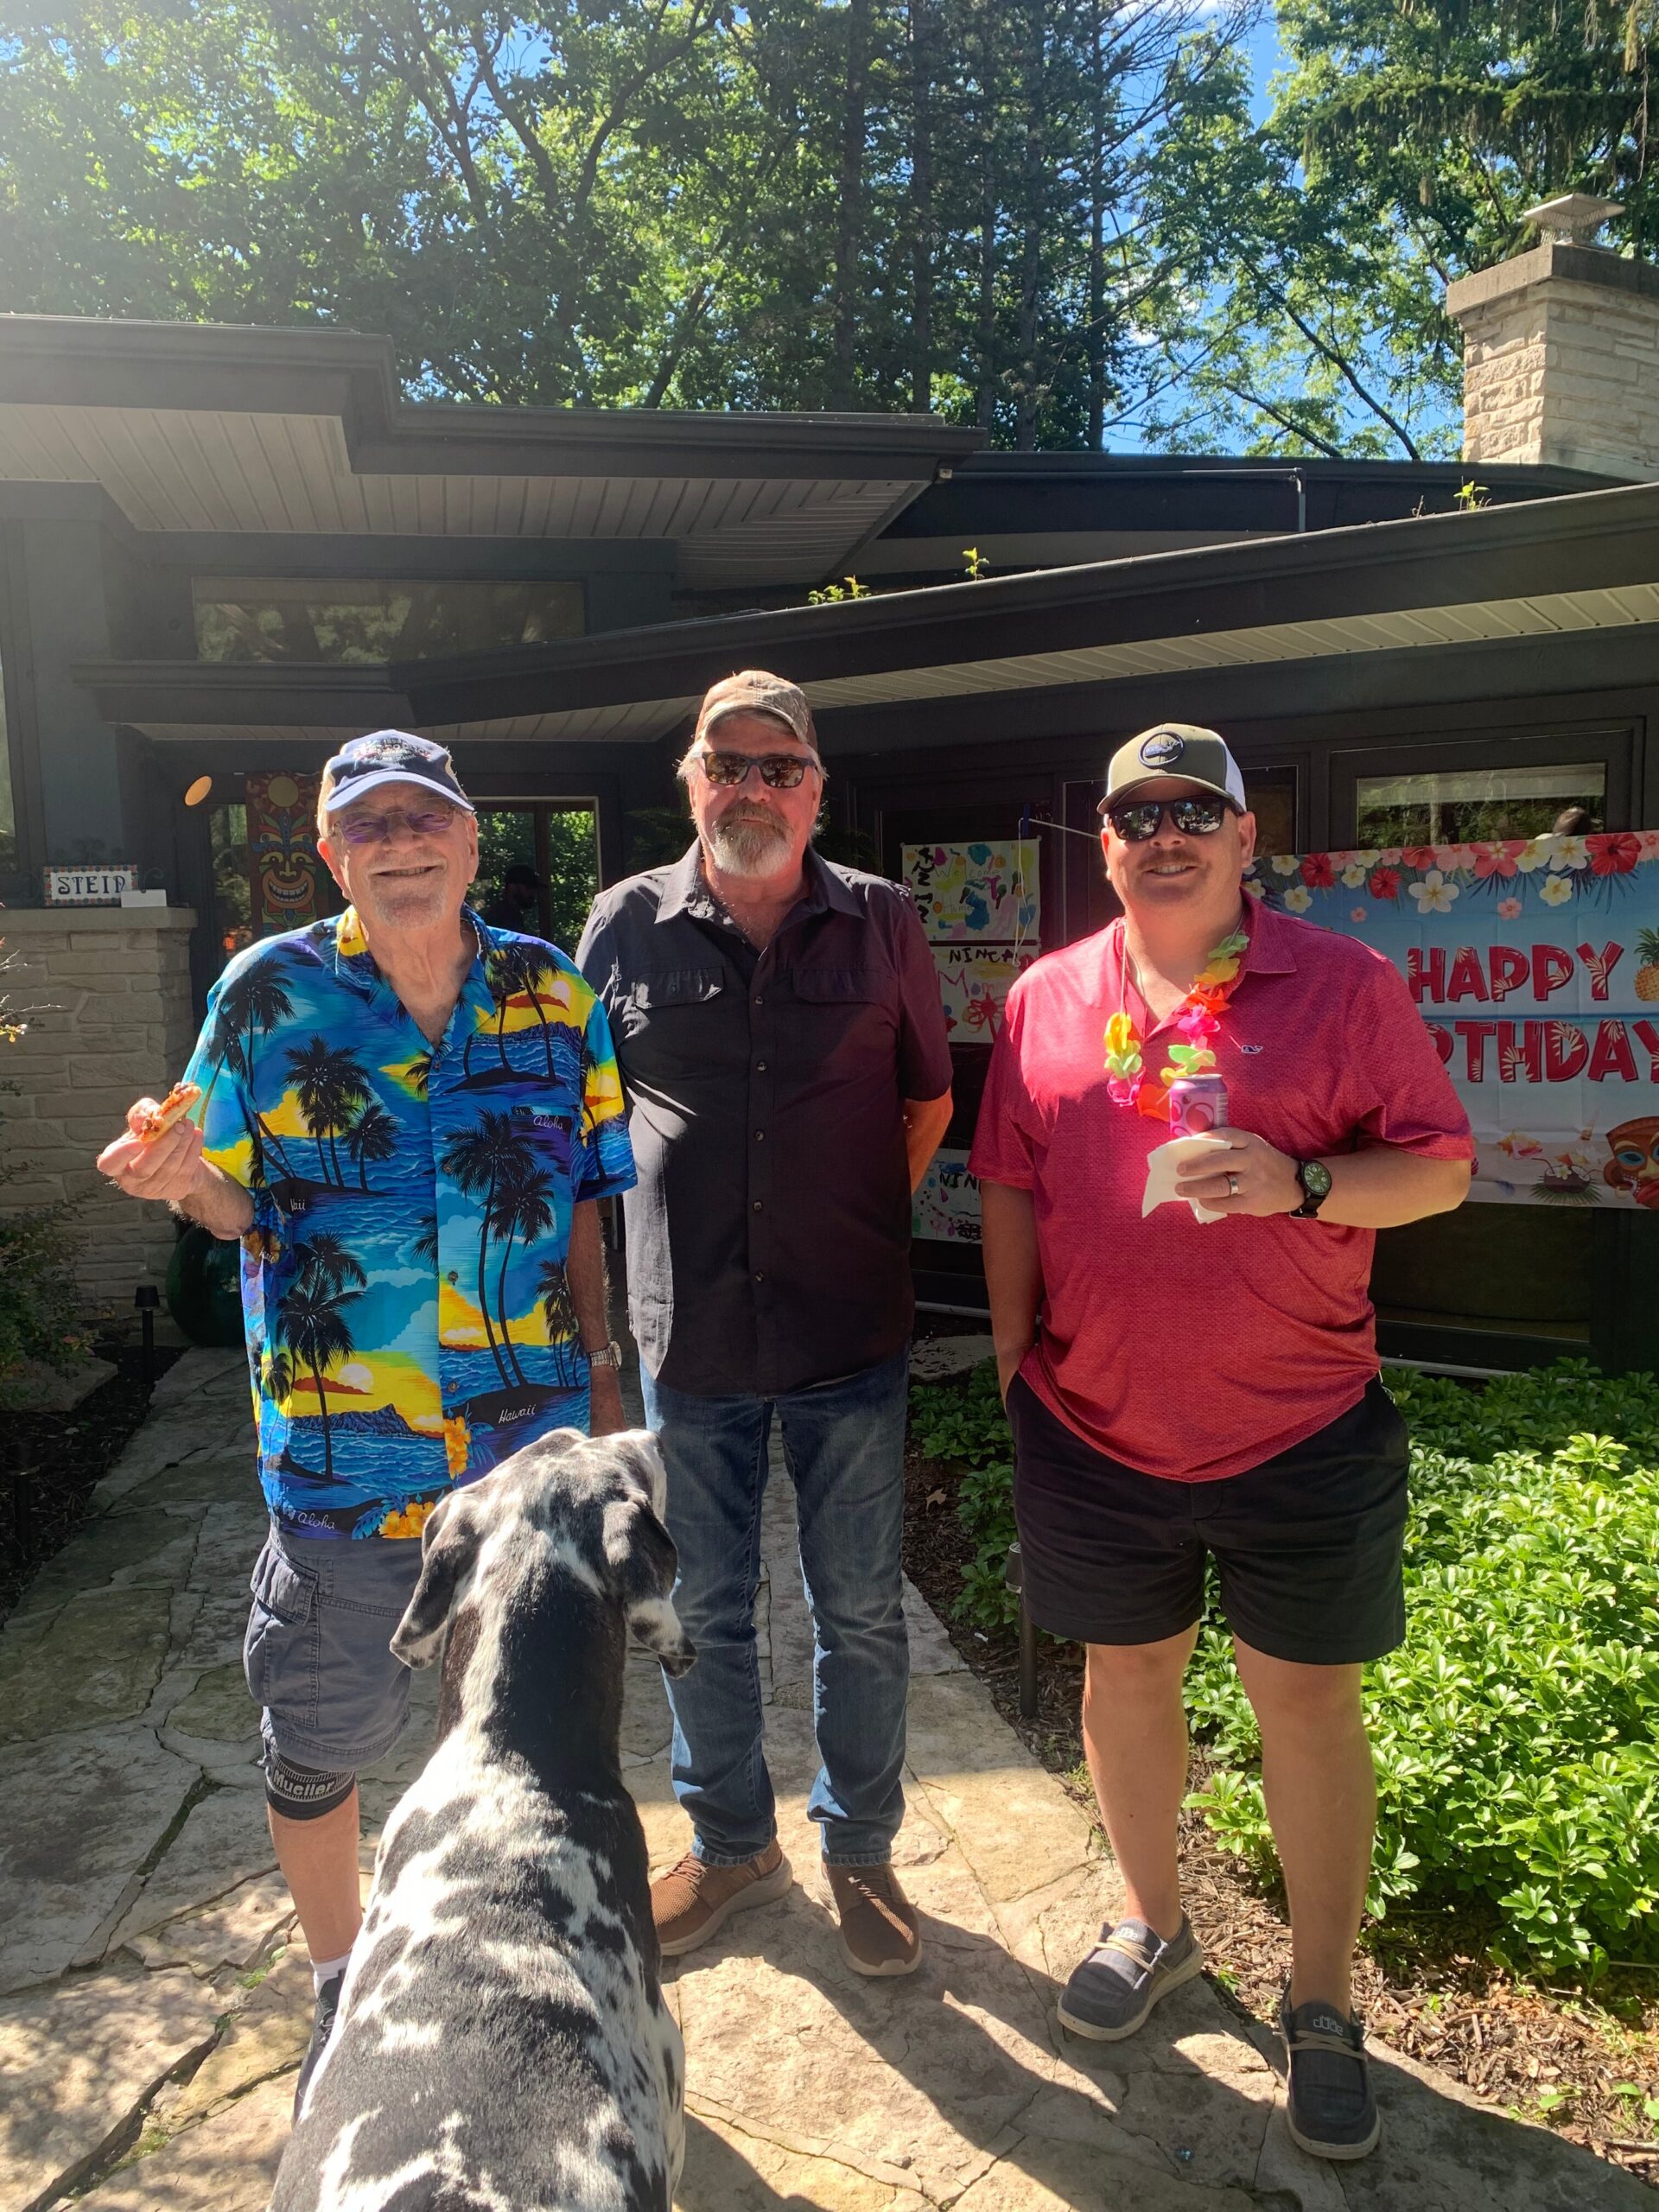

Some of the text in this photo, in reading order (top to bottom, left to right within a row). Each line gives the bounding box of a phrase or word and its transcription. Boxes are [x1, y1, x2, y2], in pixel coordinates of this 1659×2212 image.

[57, 875, 126, 895] STEIN
[1407, 940, 1624, 1003] HAPPY
[939, 1172, 977, 1191] NIN
[498, 1403, 537, 1424] Hawaii
[273, 1770, 335, 1796] Mueller
